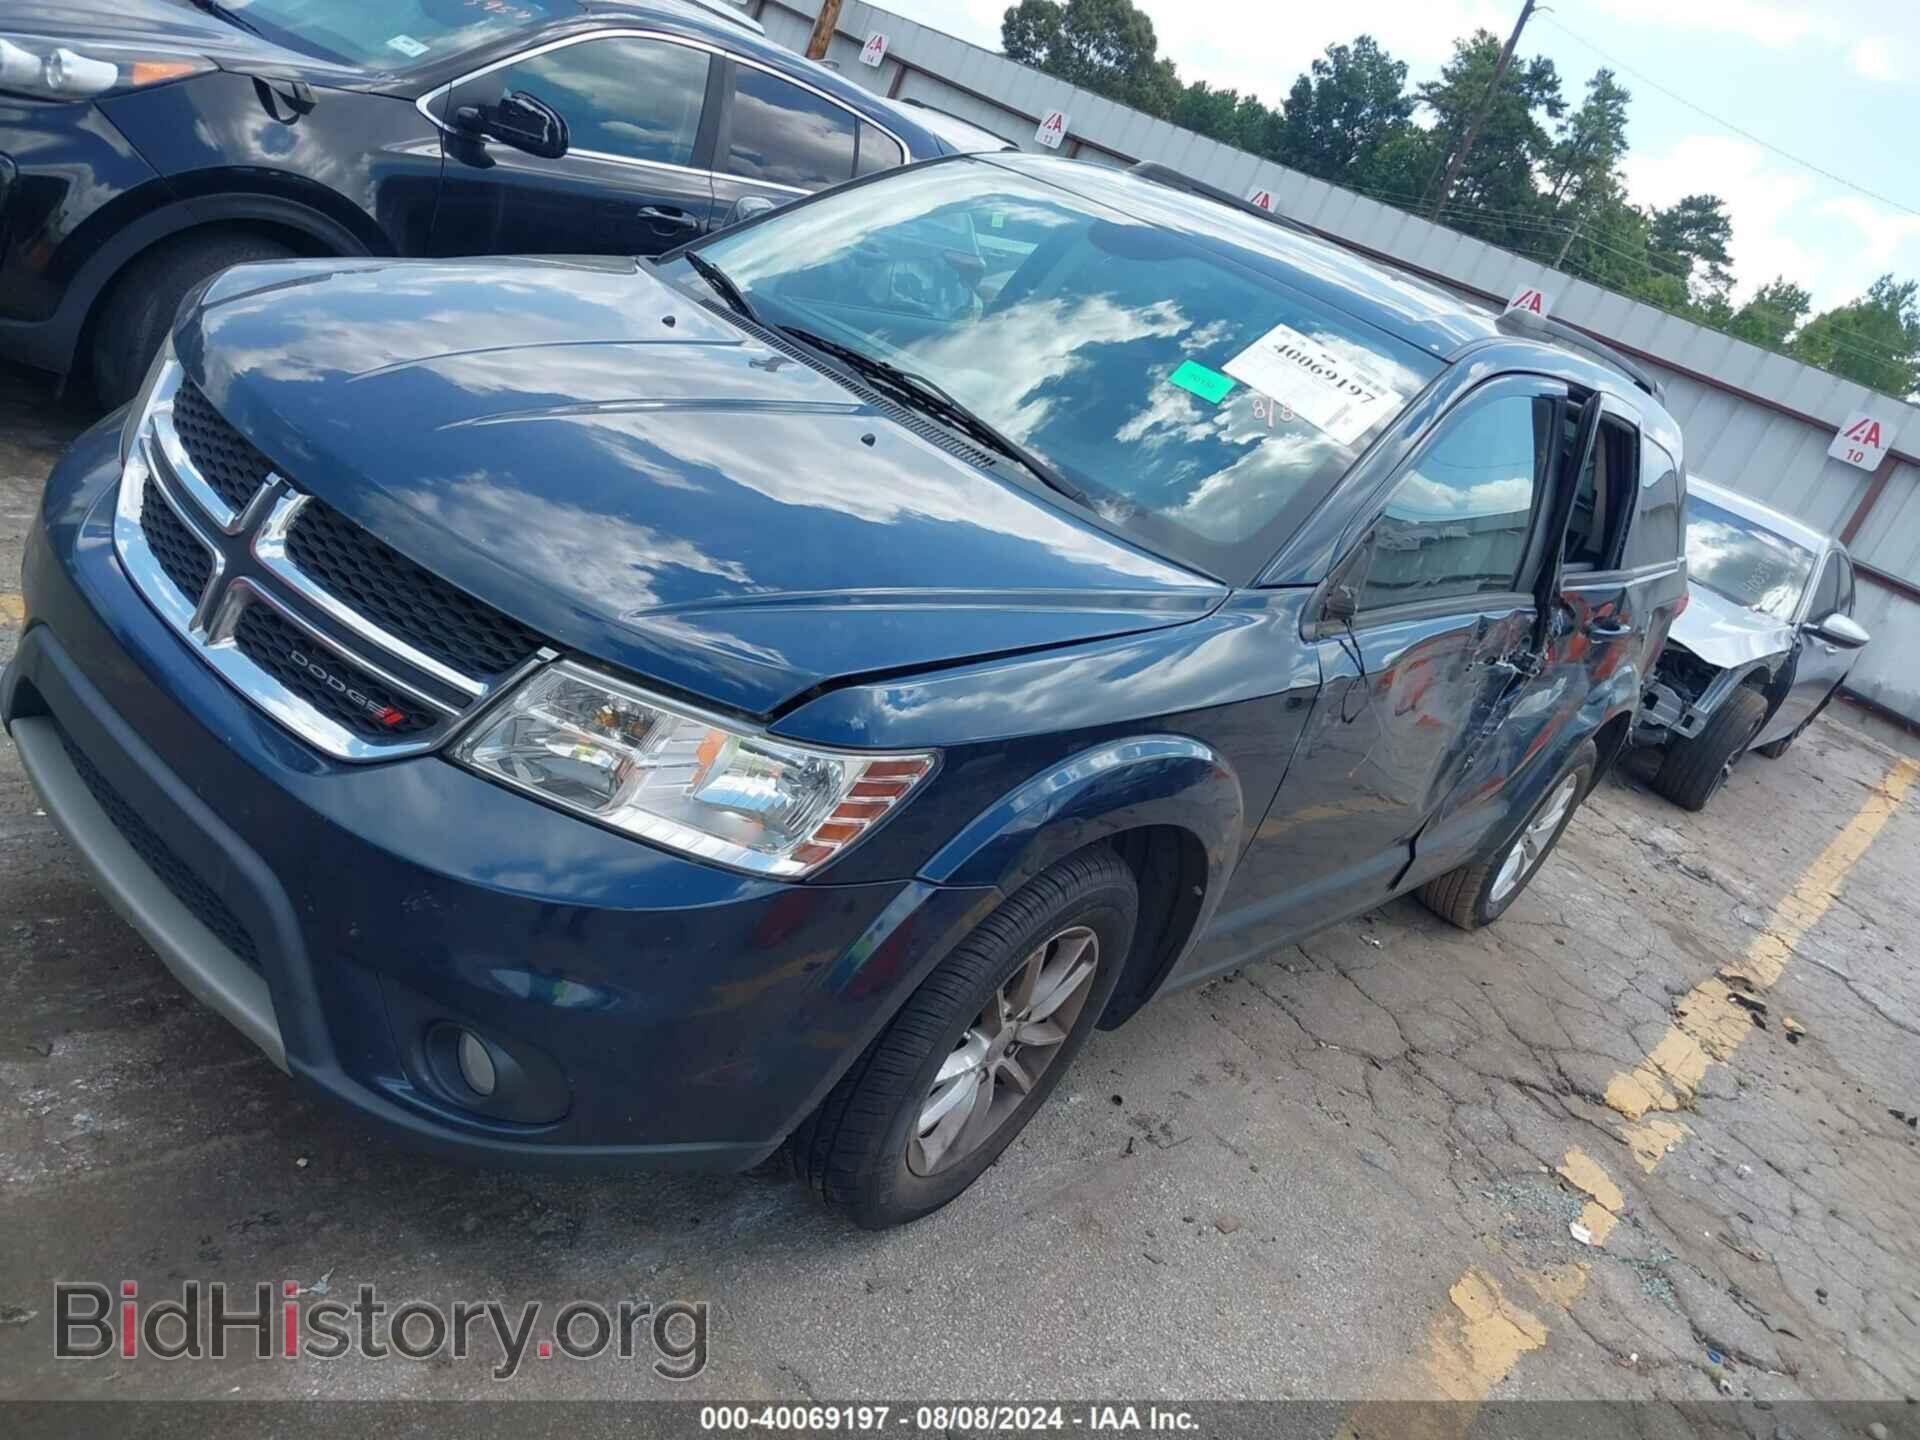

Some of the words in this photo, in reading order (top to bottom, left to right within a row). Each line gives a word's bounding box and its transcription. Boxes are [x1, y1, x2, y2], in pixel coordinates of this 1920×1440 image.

[1273, 343, 1376, 404] 40069197
[1846, 448, 1865, 464] 10
[290, 650, 387, 719] DODGE
